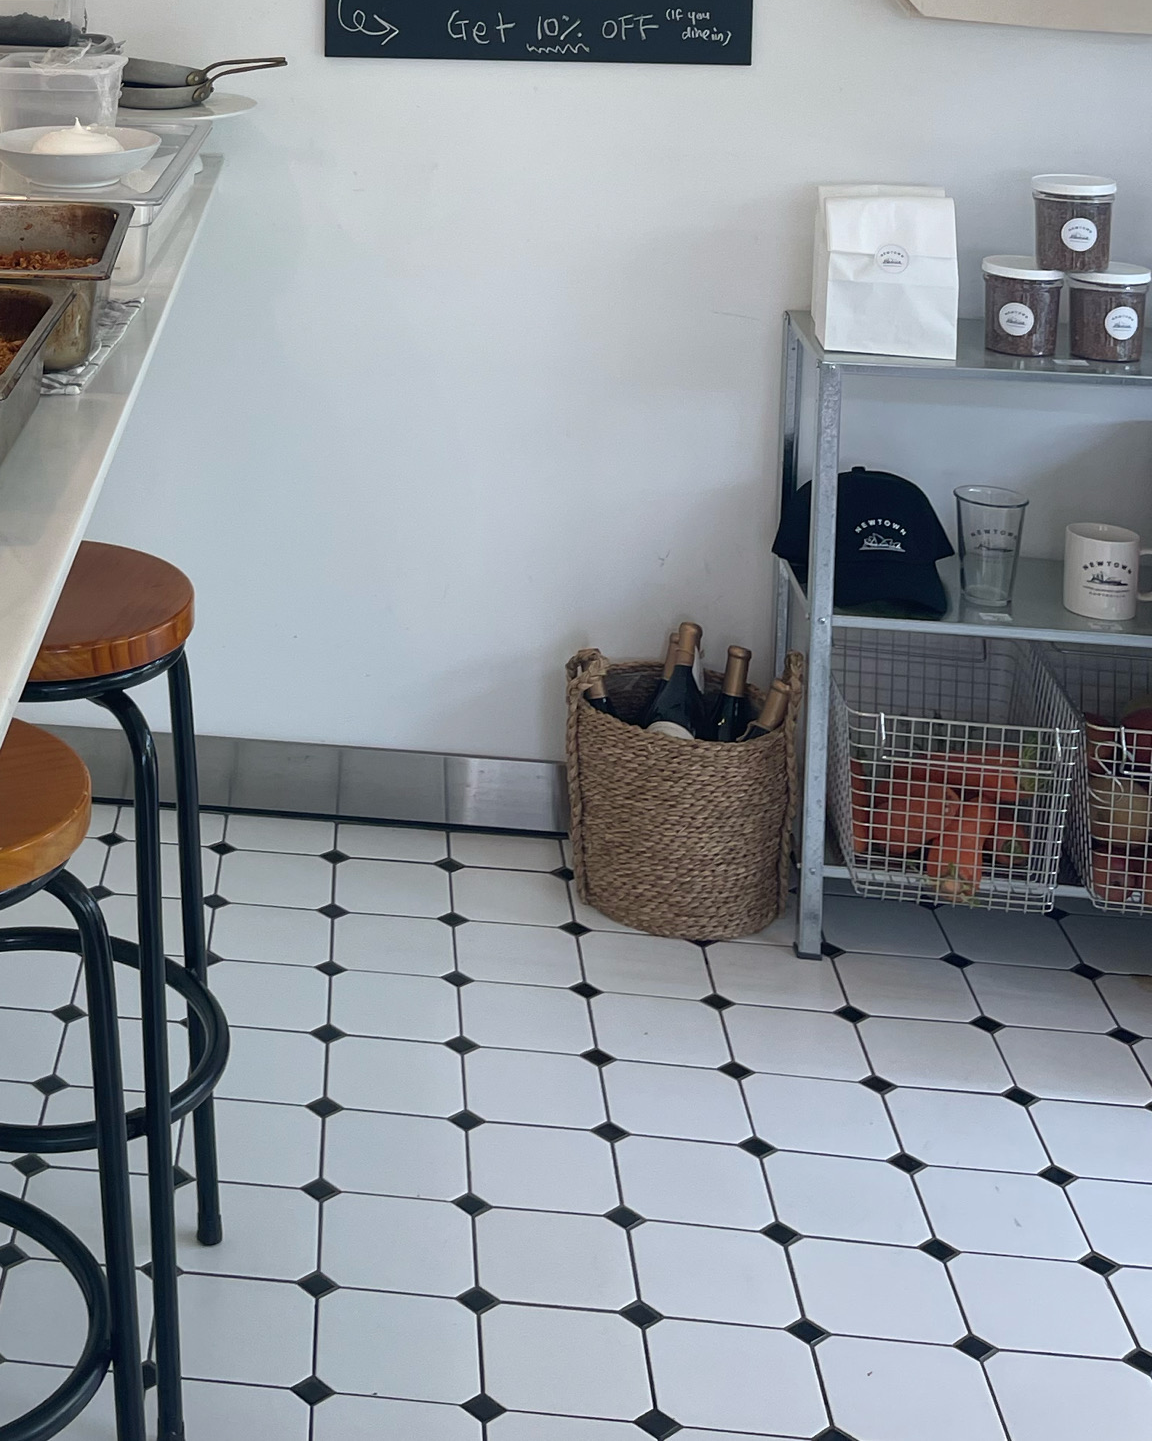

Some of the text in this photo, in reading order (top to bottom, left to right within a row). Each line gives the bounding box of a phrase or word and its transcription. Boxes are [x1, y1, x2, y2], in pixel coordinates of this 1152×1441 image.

[448, 10, 515, 44] Get
[538, 15, 582, 40] 10%
[688, 12, 709, 28] you
[854, 518, 907, 536] NEWTOWN
[1082, 560, 1132, 575] NEWTOWN
